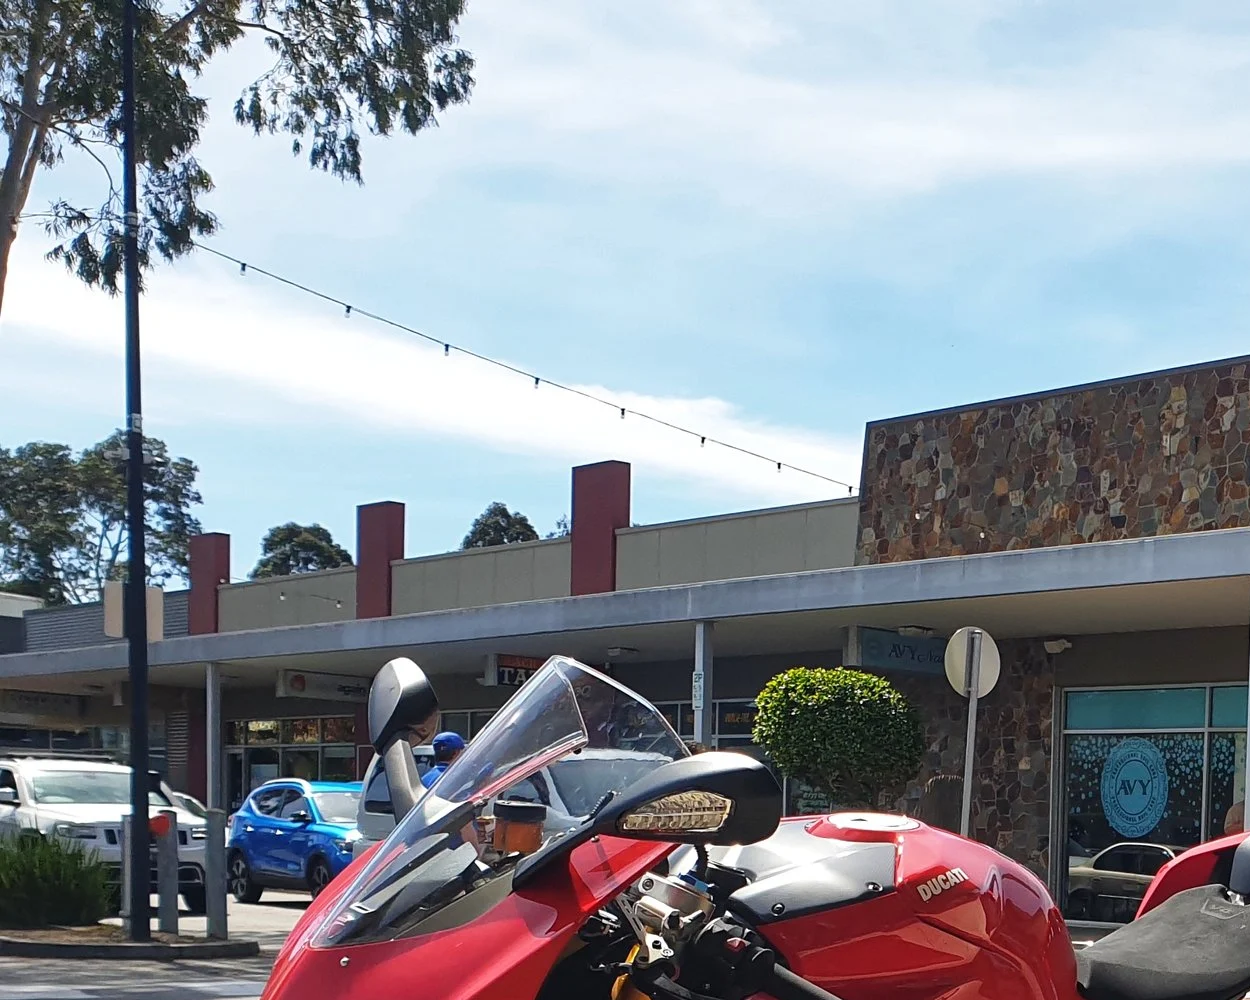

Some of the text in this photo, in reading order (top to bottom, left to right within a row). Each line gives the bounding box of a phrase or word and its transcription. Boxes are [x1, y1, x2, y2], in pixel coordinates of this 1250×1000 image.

[888, 643, 917, 660] AVY
[1117, 779, 1151, 796] AVY
[917, 868, 969, 902] DUCATI
